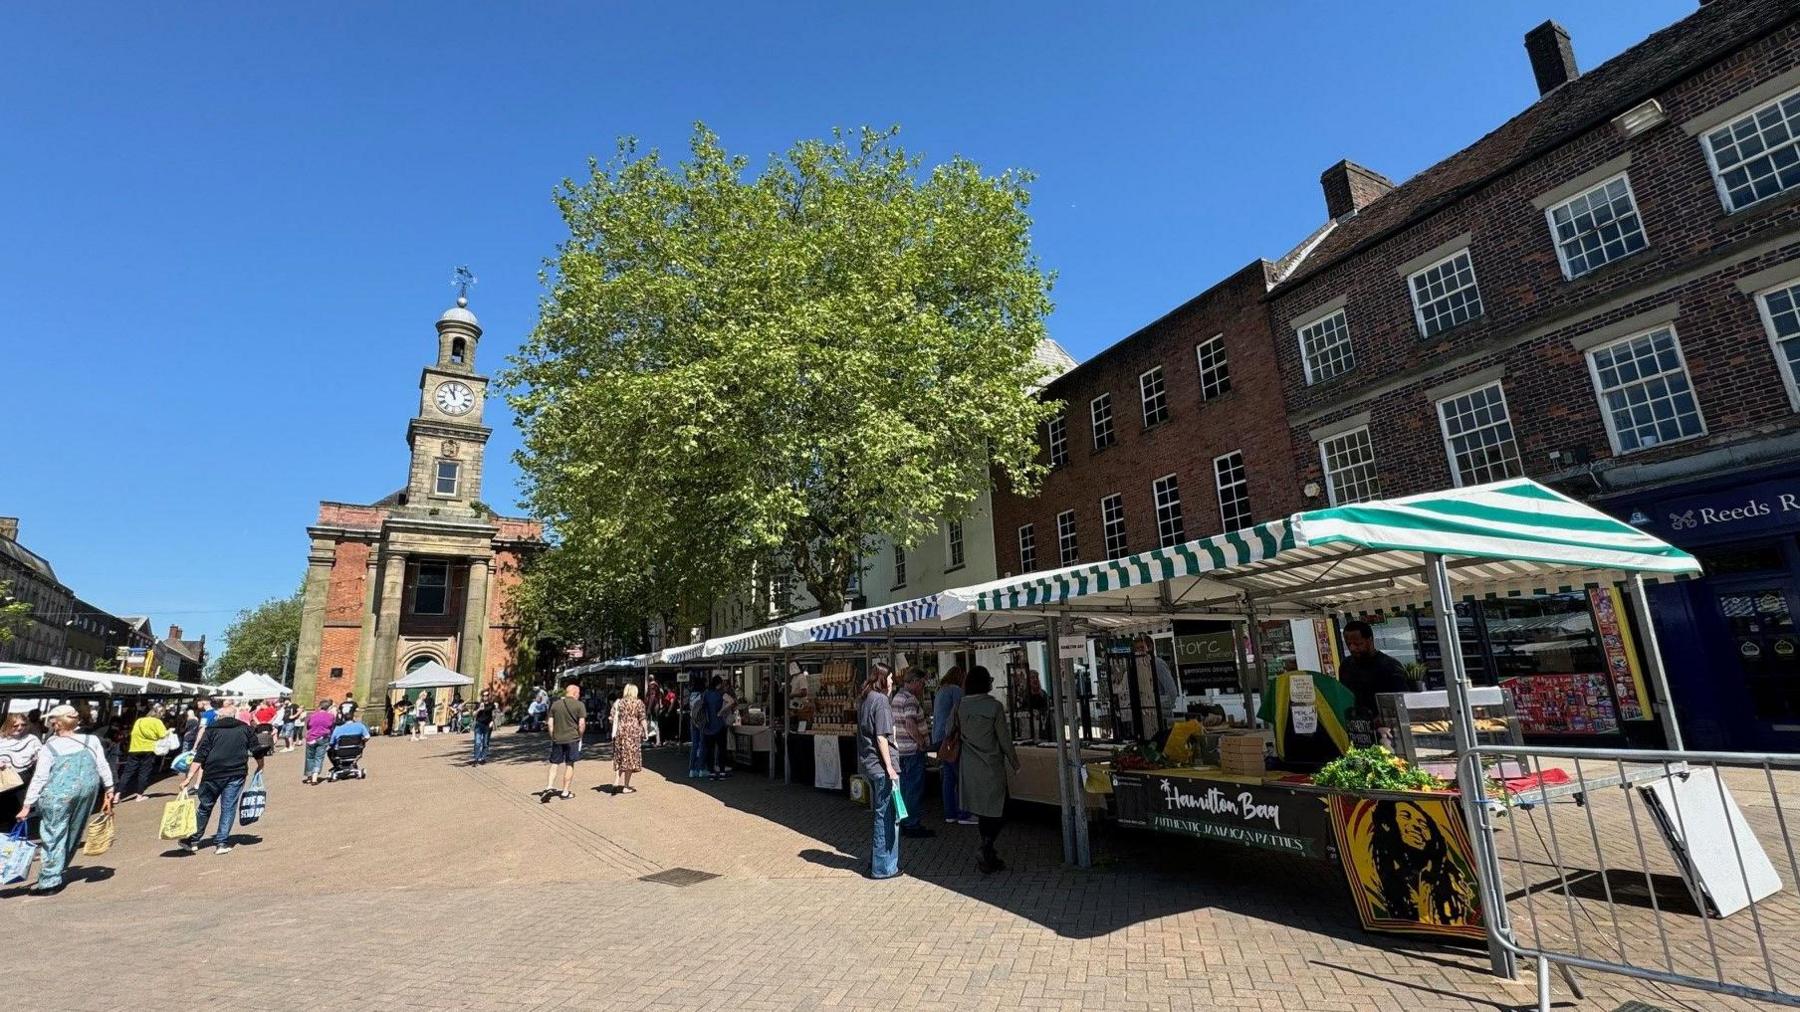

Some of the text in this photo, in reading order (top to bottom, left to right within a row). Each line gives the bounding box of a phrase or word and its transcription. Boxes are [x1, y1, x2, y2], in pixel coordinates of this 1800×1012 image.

[1700, 500, 1771, 525] Reeds
[1176, 638, 1220, 656] torc
[1162, 781, 1281, 830] Hamilton Bay
[1154, 815, 1201, 833] AUTHENTIC
[1202, 823, 1255, 843] JAMAICAN
[1255, 832, 1304, 851] PATTIES
